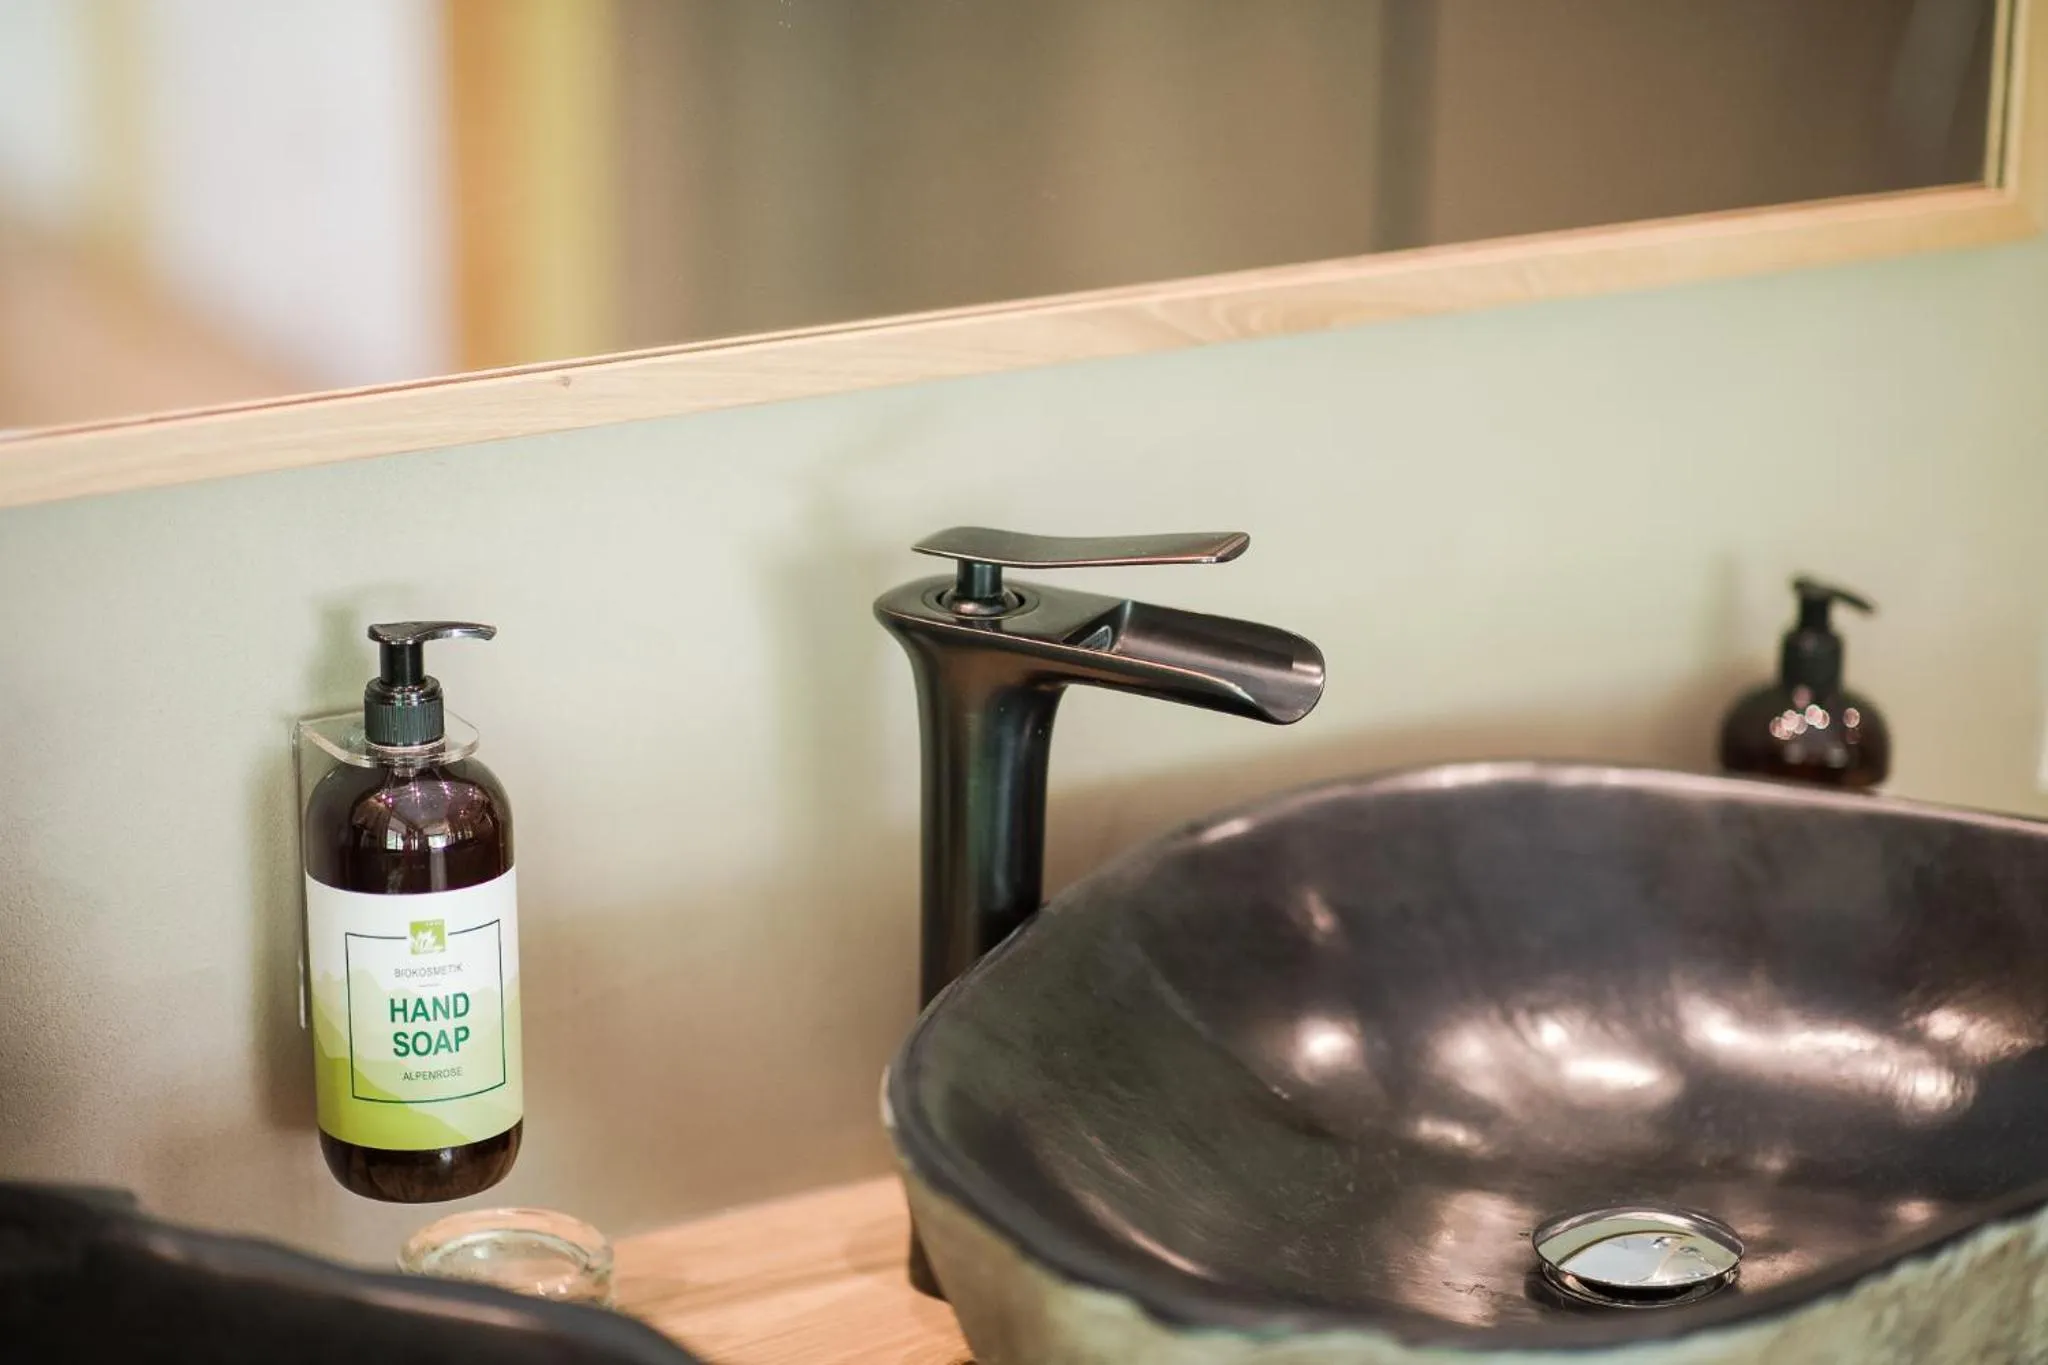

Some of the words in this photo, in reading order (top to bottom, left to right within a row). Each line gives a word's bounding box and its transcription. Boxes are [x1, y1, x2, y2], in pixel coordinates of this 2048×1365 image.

[394, 963, 463, 978] BIOKOSMETIK
[390, 992, 470, 1023] HAND
[393, 1026, 470, 1057] SOAP
[402, 1066, 464, 1081] ALPENROSE
